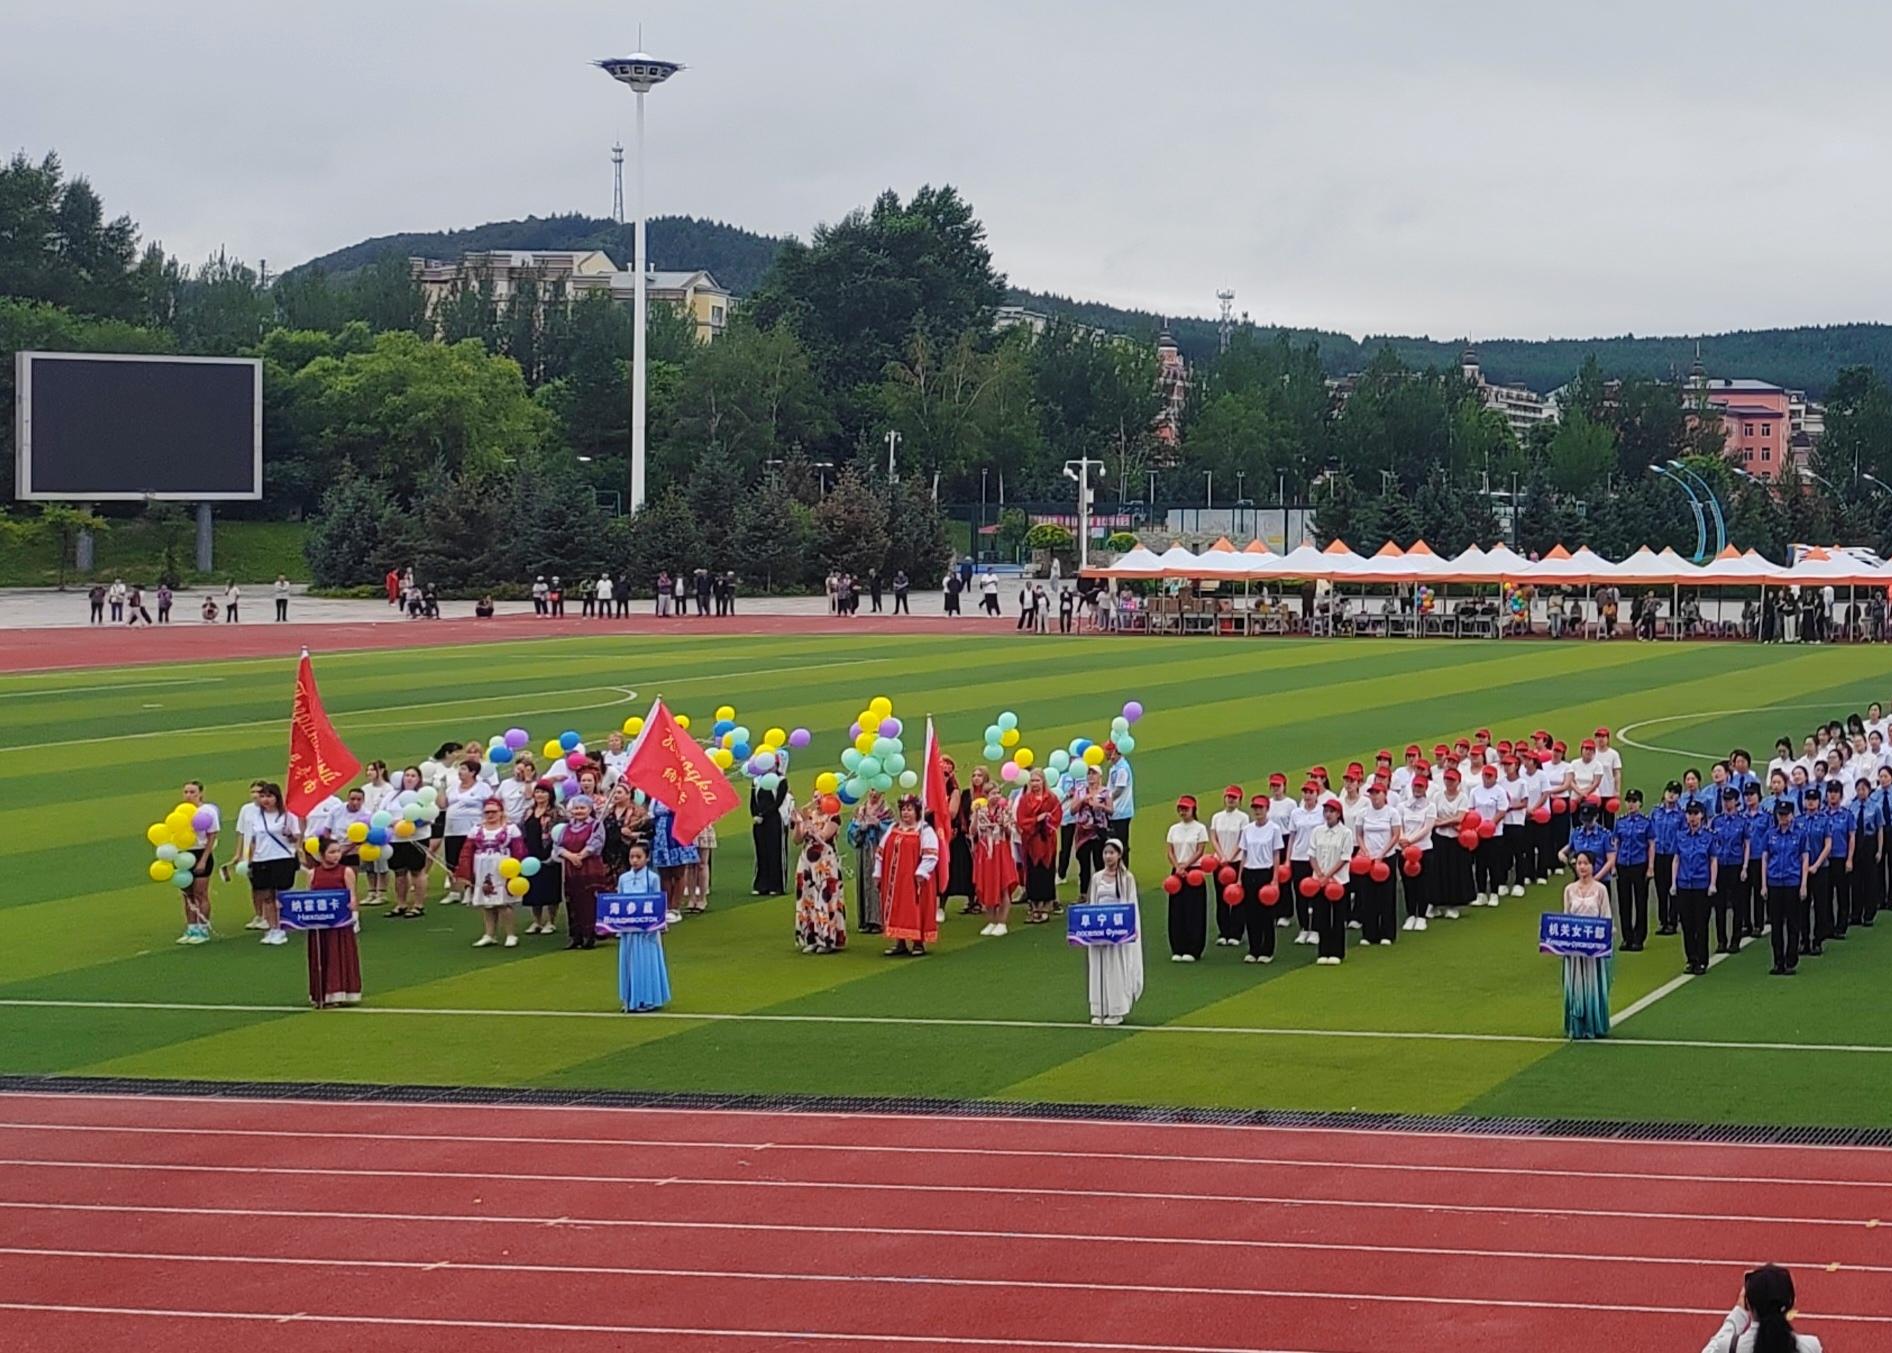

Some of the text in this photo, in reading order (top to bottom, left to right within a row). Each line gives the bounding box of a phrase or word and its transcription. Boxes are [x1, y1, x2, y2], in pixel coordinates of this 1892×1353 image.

[609, 901, 654, 915] 海参崴
[1548, 921, 1606, 940] 机关女干部
